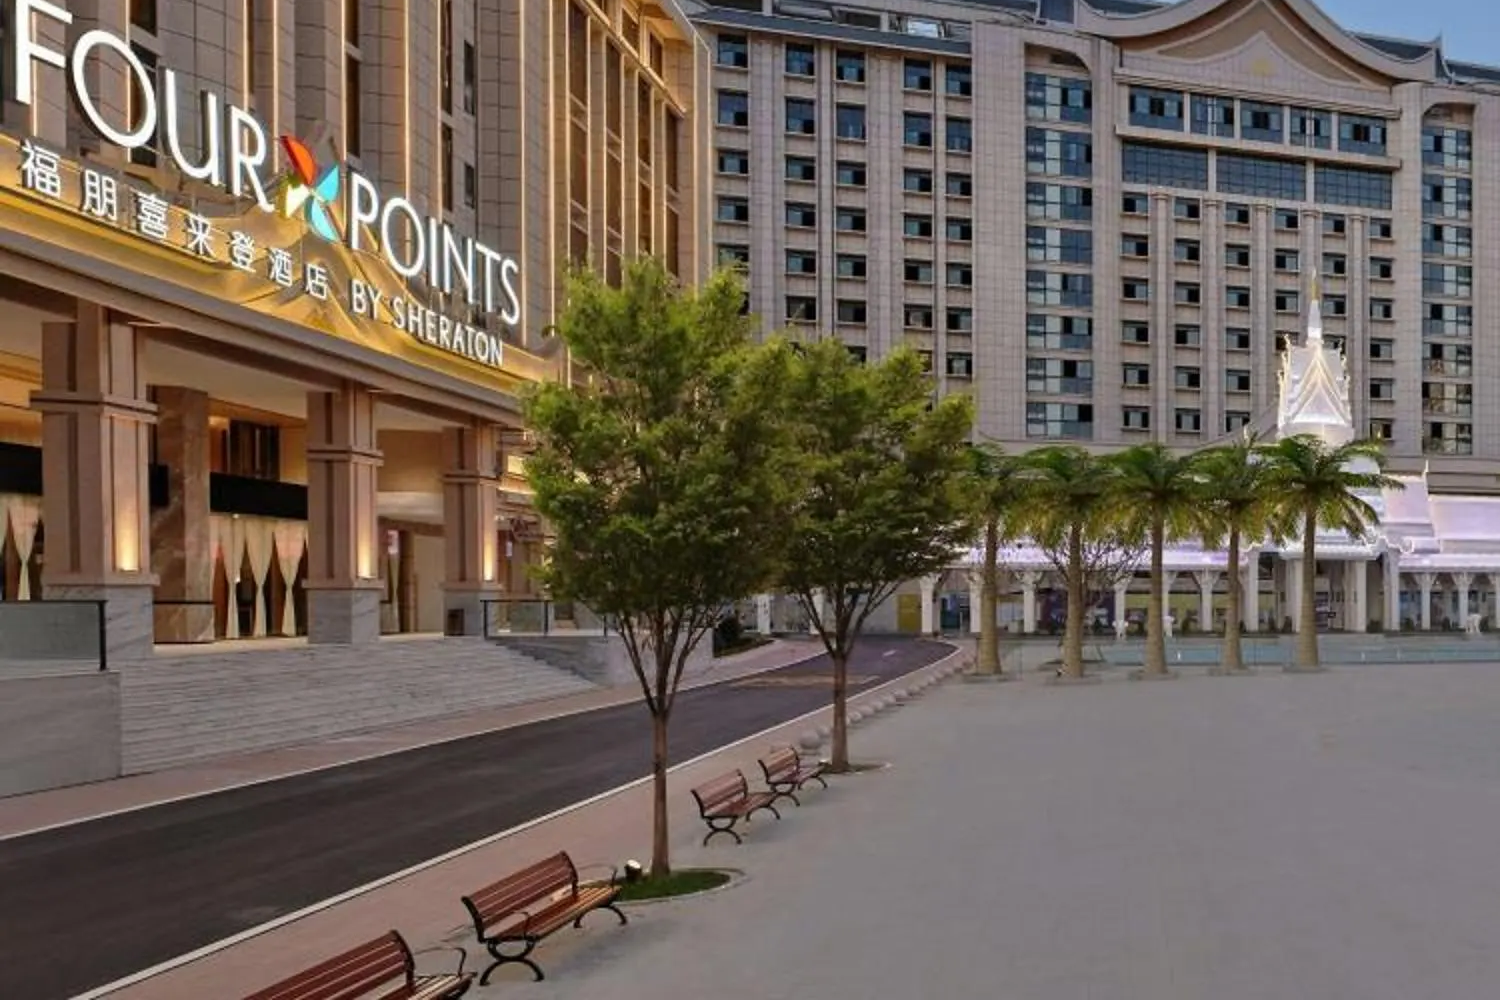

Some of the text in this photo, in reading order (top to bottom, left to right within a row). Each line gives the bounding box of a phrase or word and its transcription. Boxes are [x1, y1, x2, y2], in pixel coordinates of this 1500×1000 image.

[21, 143, 328, 300] 福朋喜来登酒店
[348, 171, 521, 326] POINTS
[350, 279, 504, 366] BY SHERATON
